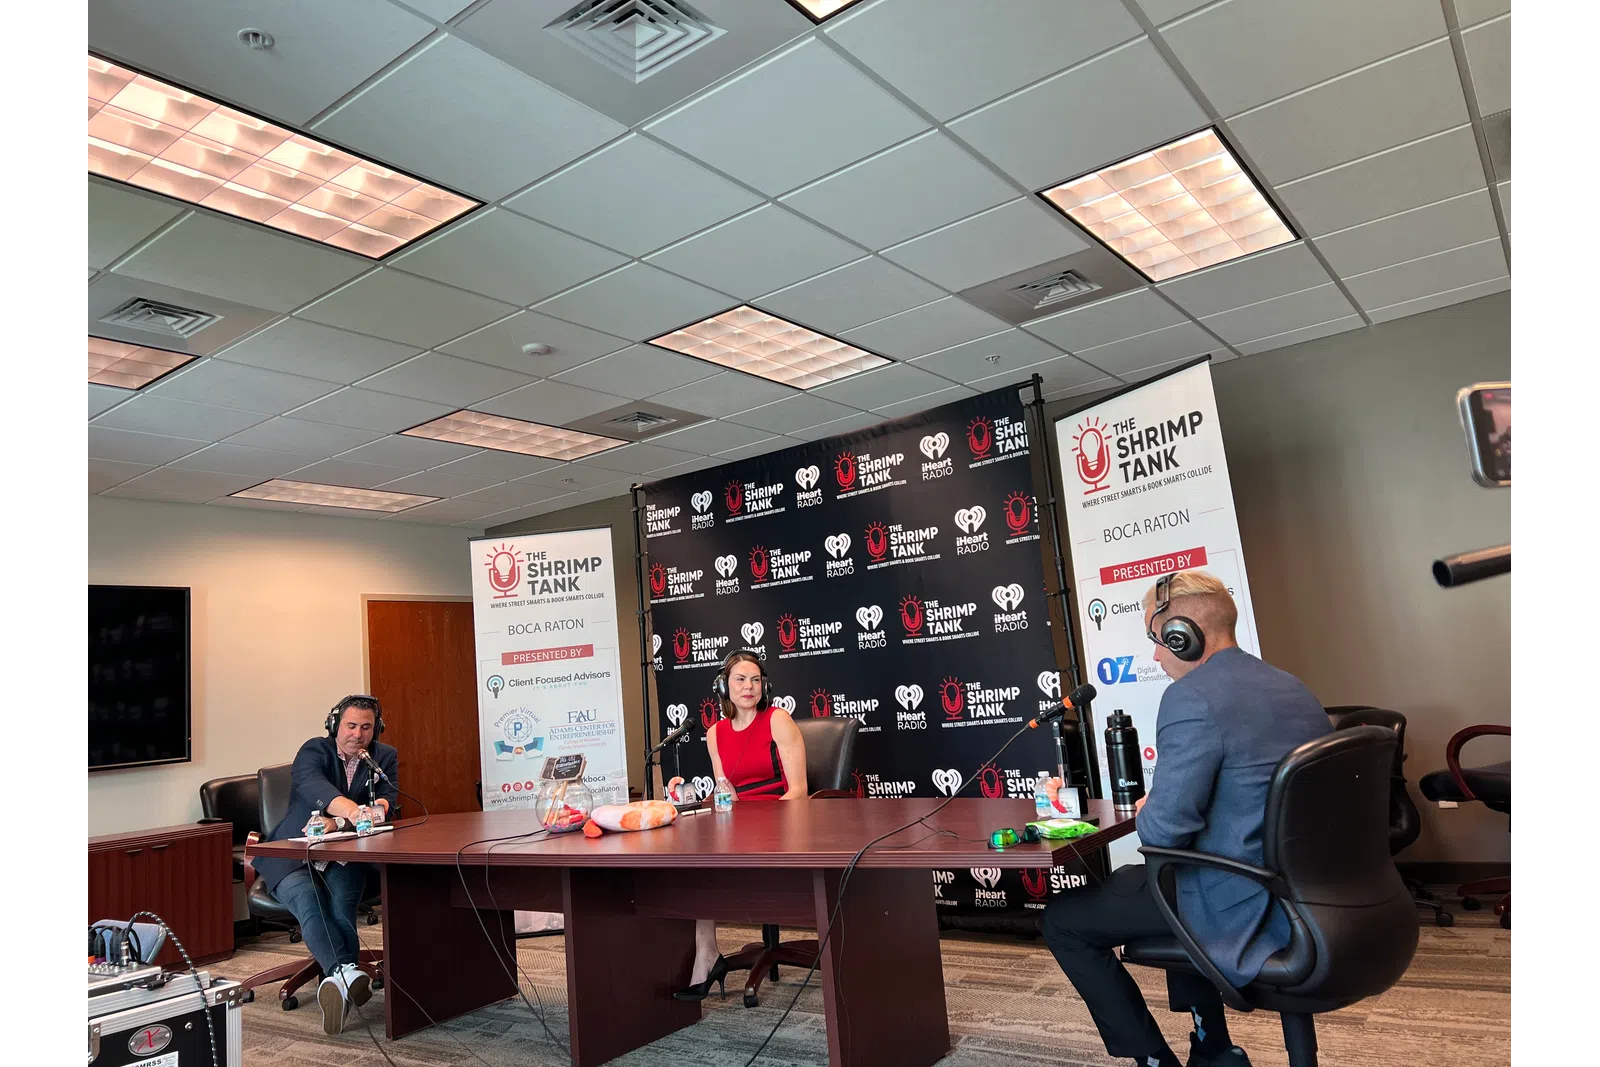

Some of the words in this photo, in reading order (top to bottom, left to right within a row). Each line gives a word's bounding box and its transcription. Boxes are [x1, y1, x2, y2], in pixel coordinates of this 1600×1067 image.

[994, 417, 1010, 427] THE
[1113, 418, 1136, 436] THE
[995, 420, 1026, 440] SHRI
[1116, 410, 1203, 459] SHRIMP
[857, 454, 870, 462] THE
[858, 453, 904, 475] SHRIMP
[1119, 446, 1180, 483] TANK
[921, 458, 952, 473] iHeart
[859, 469, 892, 487] TANK
[922, 467, 953, 481] RADIO
[744, 482, 755, 490] THE
[745, 483, 784, 501] SHRIMP
[1082, 498, 1100, 508] WHERE
[1101, 492, 1120, 504] STREET
[1121, 486, 1141, 499] SMARTS
[1148, 480, 1162, 490] BOOK
[1164, 473, 1186, 486] SMARTS
[1187, 465, 1212, 479] COLLIDE
[796, 488, 821, 500] iHeart
[745, 498, 773, 513] TANK
[797, 497, 823, 508] RADIO
[646, 506, 680, 521] SHRIMP
[692, 512, 713, 523] iHeart
[647, 519, 671, 532] TANK
[692, 520, 714, 531] RADIO
[889, 524, 902, 532] THE
[1104, 522, 1141, 543] BOCA
[1144, 508, 1190, 533] RATON
[890, 526, 939, 546] SHRIMP
[956, 532, 988, 547] iHeart
[891, 542, 924, 558] TANK
[956, 541, 990, 556] RADIO
[526, 552, 547, 561] THE
[770, 550, 812, 568] SHRIMP
[527, 557, 602, 578] SHRIMP
[826, 558, 853, 570] iHeart
[1113, 558, 1175, 581] PRESENTED
[1178, 554, 1192, 568] BY
[668, 570, 703, 585] SHRIMP
[771, 565, 800, 580] TANK
[826, 566, 854, 578] RADIO
[528, 576, 580, 596] TANK
[668, 583, 693, 596] TANK
[716, 577, 739, 588] iHeart
[716, 585, 740, 596] RADIO
[926, 603, 977, 622] SHRIMP
[1111, 601, 1140, 615] Client
[994, 610, 1027, 623] iHeart
[508, 622, 542, 636] BOCA
[545, 618, 584, 632] RATON
[800, 622, 842, 636] SHRIMP
[927, 619, 963, 635] TANK
[995, 621, 1028, 633] RADIO
[858, 630, 886, 641] iHeart
[692, 636, 729, 650] SHRIMP
[800, 636, 831, 650] TANK
[858, 639, 887, 650] RADIO
[513, 650, 567, 663] PRESENTED
[571, 648, 582, 657] BY
[692, 649, 719, 662] TANK
[1137, 666, 1157, 676] Digital
[509, 678, 533, 688] Client
[536, 674, 571, 684] Focused
[574, 671, 610, 680] Advisors
[966, 682, 981, 691] THE
[967, 687, 1021, 704] SHRIMP
[834, 699, 879, 714] SHRIMP
[968, 703, 1006, 718] TANK
[494, 708, 518, 728] Premier
[520, 707, 541, 723] Virtual
[568, 709, 597, 723] FAU
[897, 711, 926, 722] iHeart
[514, 722, 522, 736] P
[898, 720, 927, 730] RADIO
[549, 729, 616, 740] ENTREPRENEURSHIP
[1004, 769, 1021, 778] THE
[868, 781, 916, 795] SHRIMP
[1007, 777, 1038, 792] SHR
[491, 794, 538, 804] www.ShrimpTa
[932, 871, 955, 884] IMP
[1050, 874, 1087, 889] SHRI
[975, 889, 1006, 900] iHeart
[975, 900, 1007, 908] RADIO
